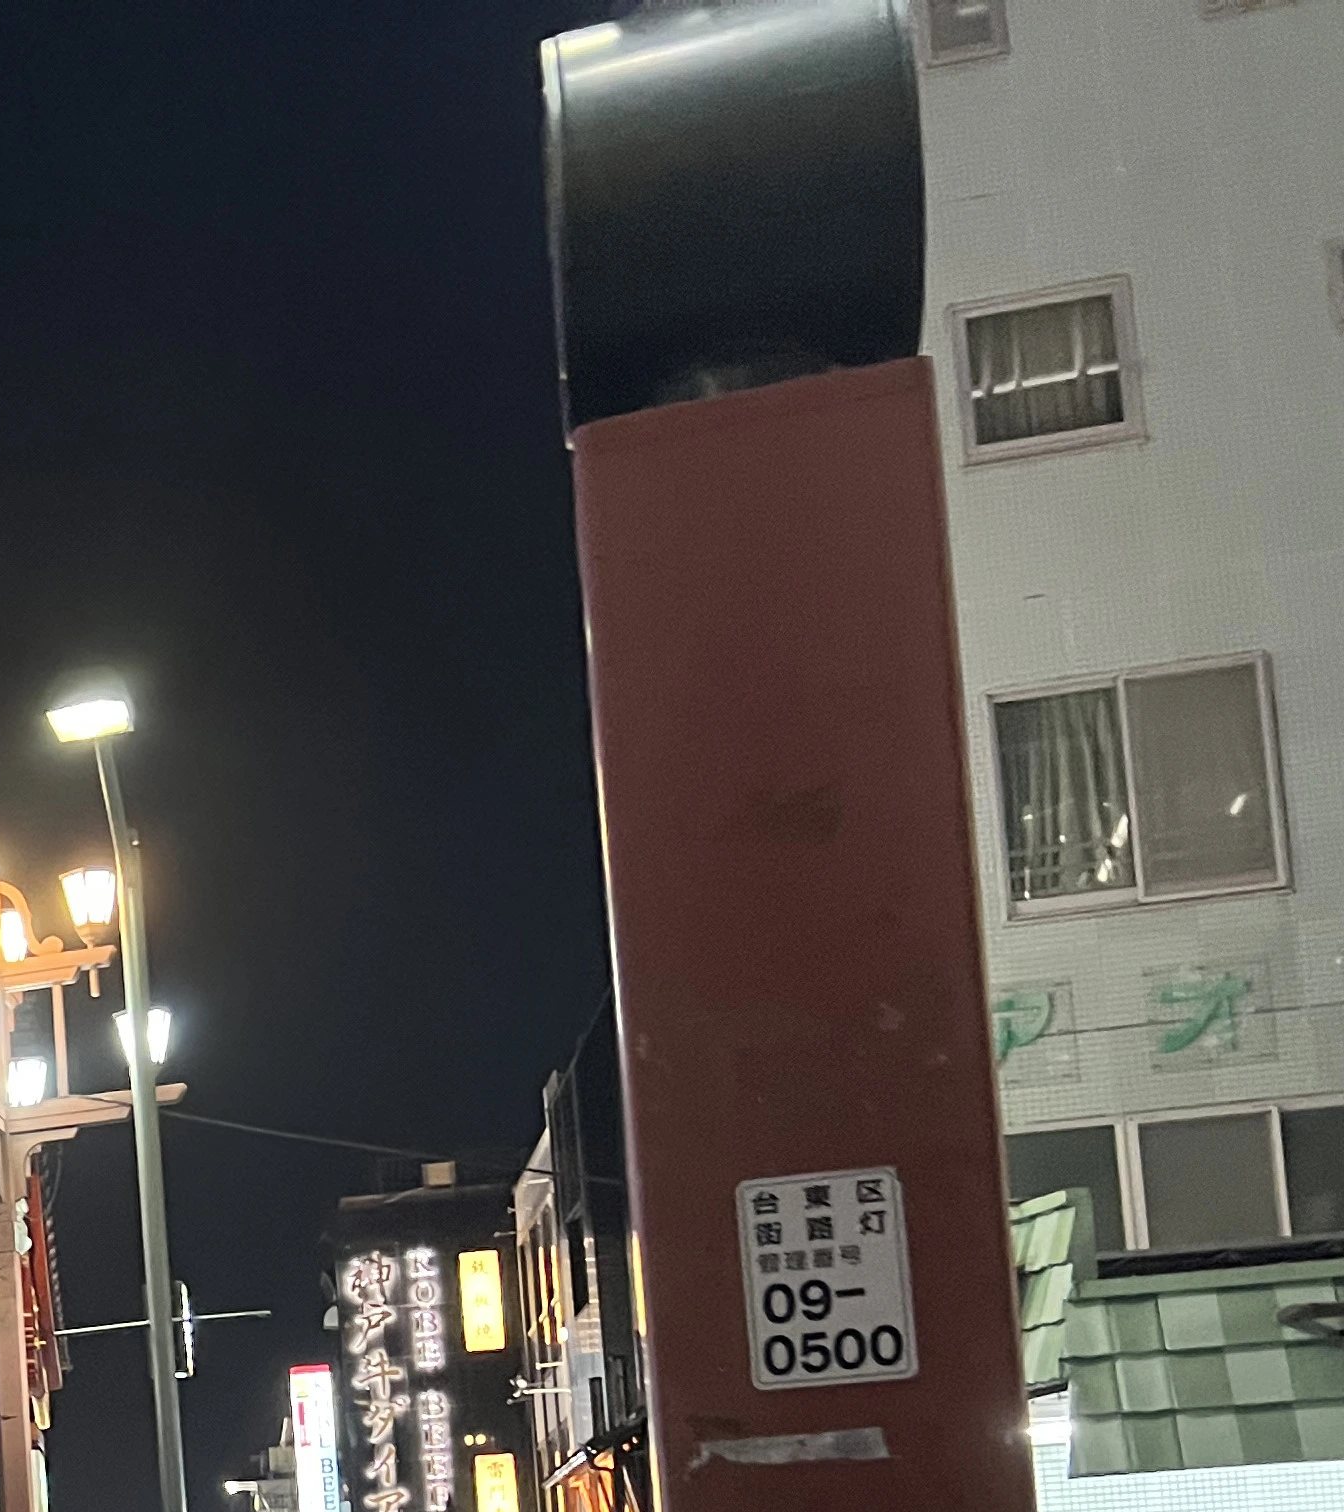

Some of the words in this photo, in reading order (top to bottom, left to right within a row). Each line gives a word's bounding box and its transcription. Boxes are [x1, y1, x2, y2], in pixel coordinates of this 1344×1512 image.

[752, 1178, 885, 1215] 台東区
[406, 1249, 446, 1370] KOBE
[763, 1324, 904, 1376] 0500
[416, 1391, 450, 1512] BEEF
